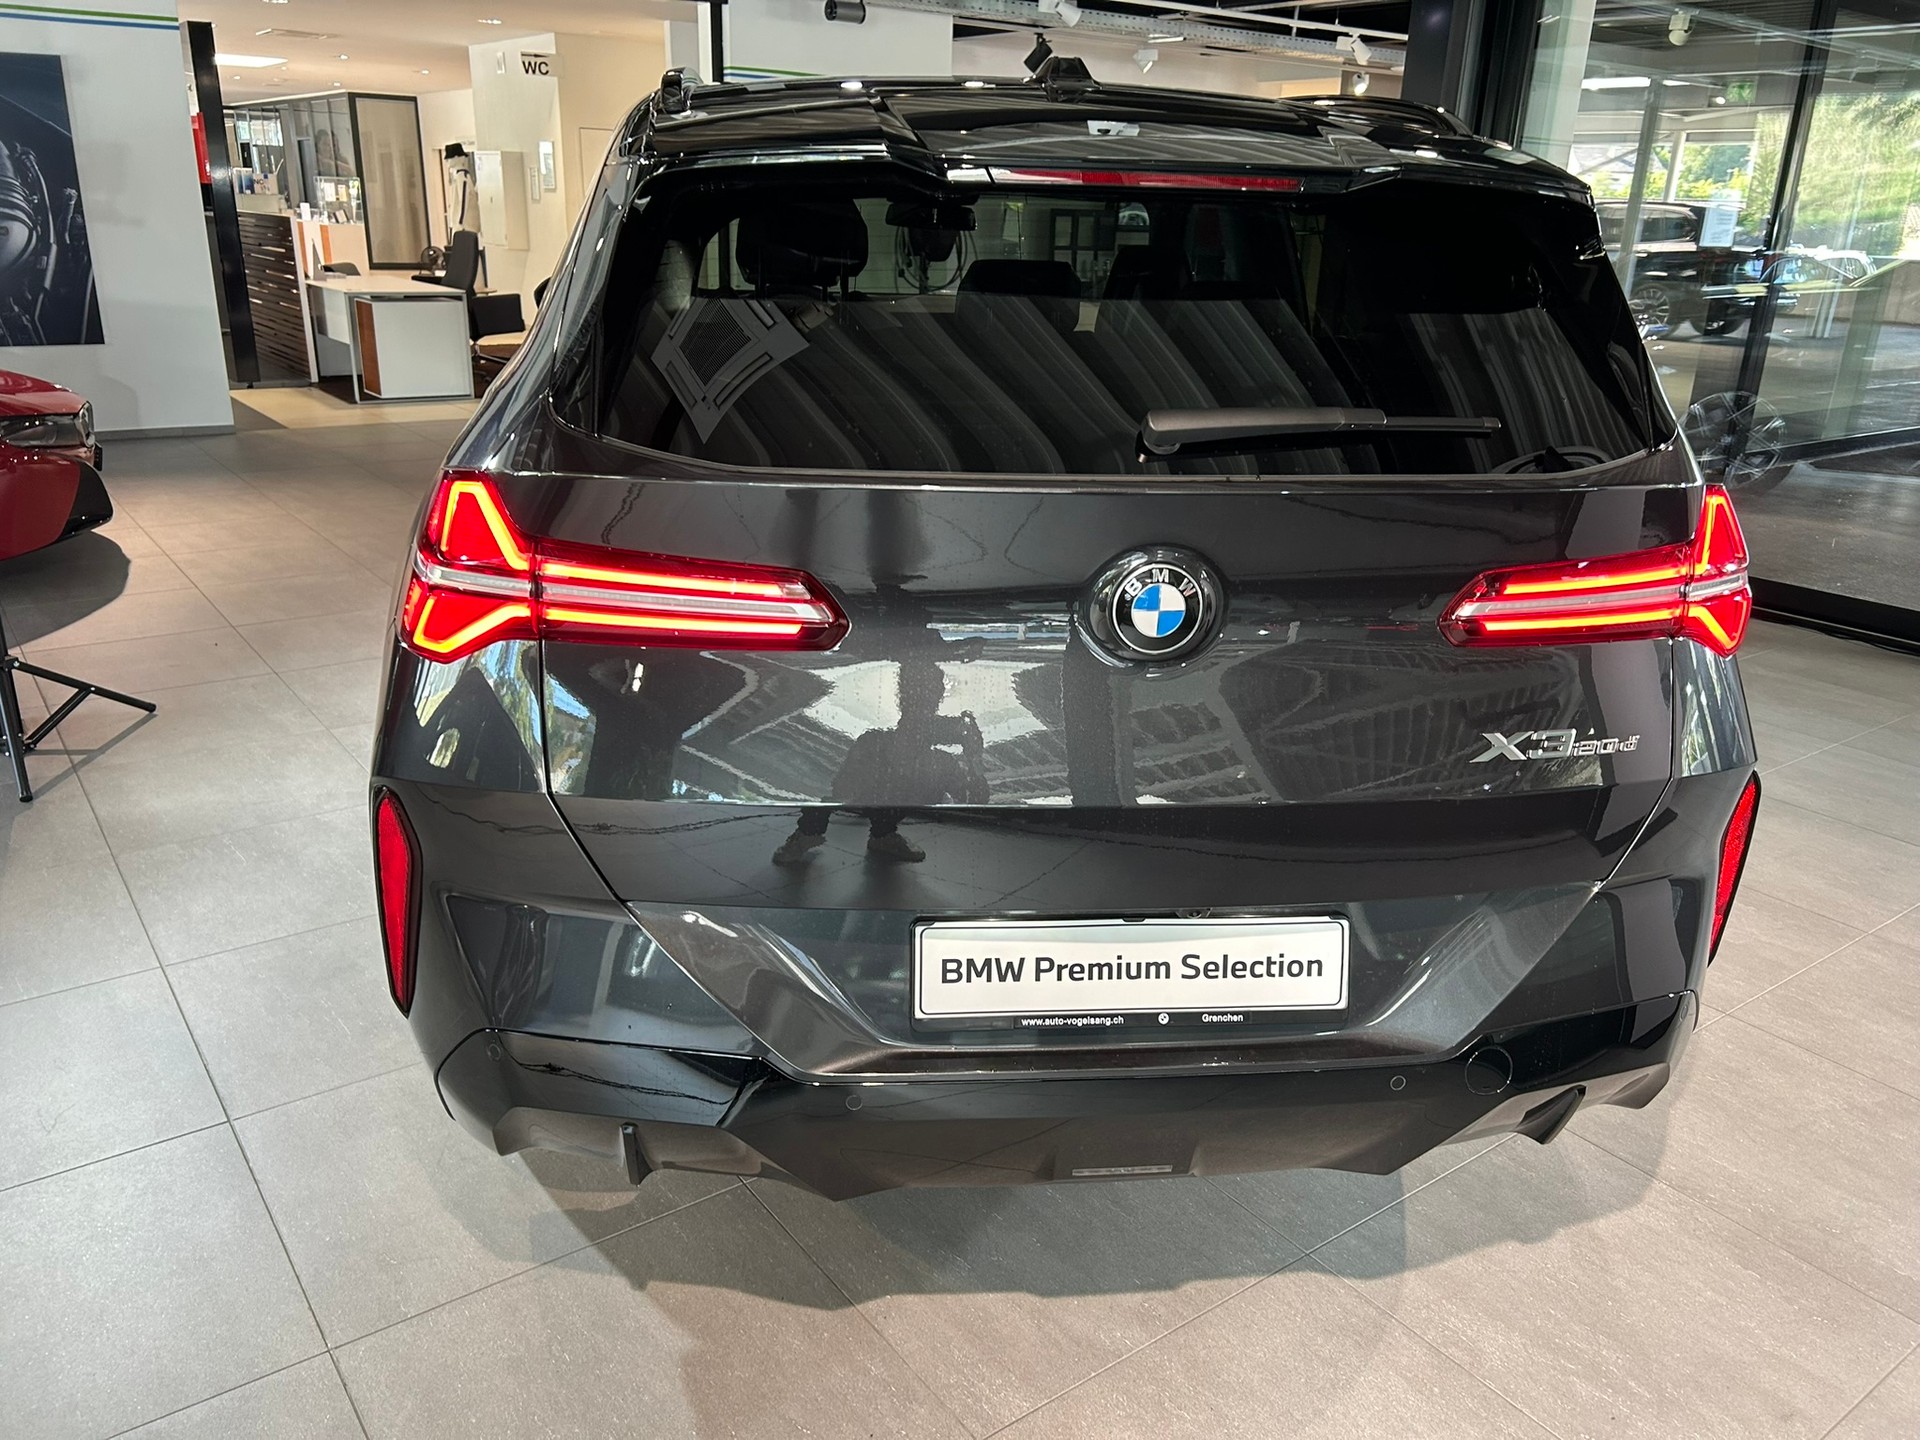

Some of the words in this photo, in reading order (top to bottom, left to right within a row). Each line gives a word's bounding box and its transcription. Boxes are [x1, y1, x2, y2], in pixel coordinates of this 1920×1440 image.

[522, 60, 549, 76] WC
[1124, 568, 1197, 597] BMW
[1469, 728, 1577, 763] X3
[941, 957, 1025, 984] BMW
[1034, 954, 1171, 983] Premium
[1181, 952, 1323, 980] Selection
[1021, 1015, 1124, 1027] www.auto-vogelsang.ch
[1201, 1012, 1244, 1023] Grenchen
